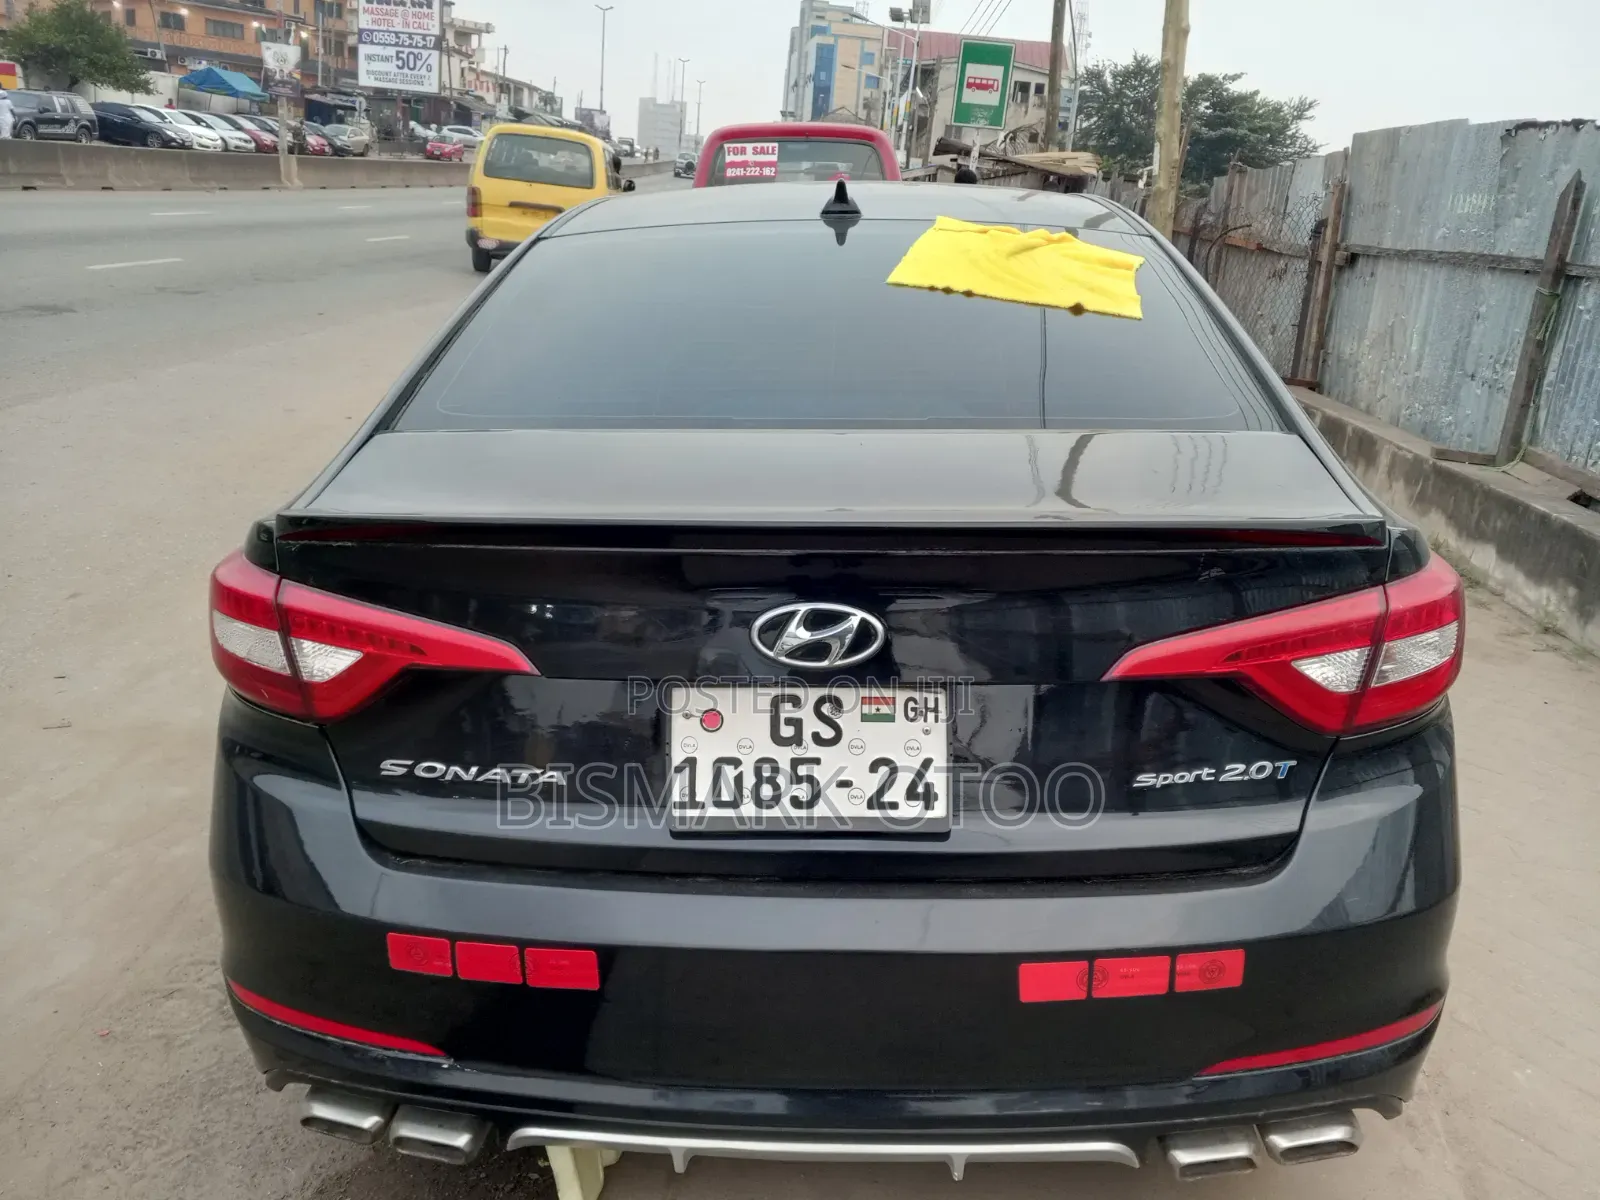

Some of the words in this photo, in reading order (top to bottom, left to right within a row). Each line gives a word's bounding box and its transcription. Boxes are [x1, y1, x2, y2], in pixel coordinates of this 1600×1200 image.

[362, 6, 399, 18] MASSAGE
[401, 9, 410, 20] @
[412, 11, 435, 21] HOME
[371, 17, 396, 28] HOTEL
[402, 20, 411, 29] IN
[412, 21, 431, 31] CALL
[372, 31, 436, 48] 0559-75-75-17
[364, 53, 394, 64] INSTANT
[395, 50, 432, 73] 50%
[366, 69, 392, 77] DISCOUNT
[393, 71, 409, 79] AFTER
[373, 76, 397, 84] MASSAGE
[727, 146, 747, 156] FOR
[752, 145, 777, 156] SALE
[726, 166, 776, 177] 0241-222-162
[770, 694, 843, 747] GS
[903, 696, 939, 723] GH
[379, 759, 567, 785] SONATA
[1132, 767, 1216, 788] Sport
[1219, 760, 1298, 782] 2.0T
